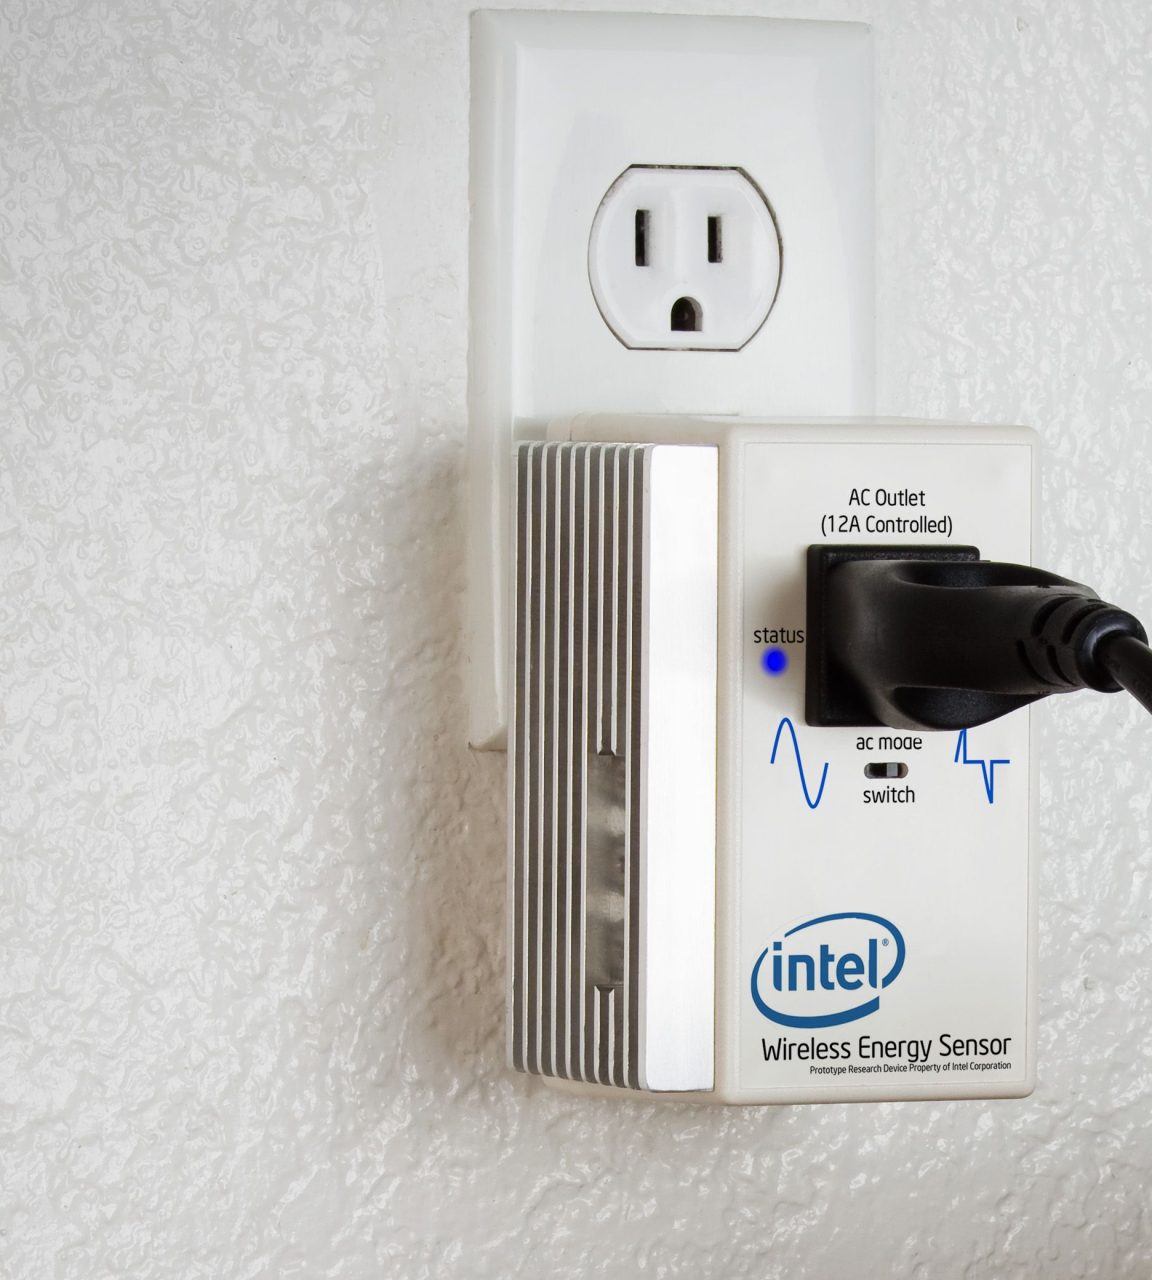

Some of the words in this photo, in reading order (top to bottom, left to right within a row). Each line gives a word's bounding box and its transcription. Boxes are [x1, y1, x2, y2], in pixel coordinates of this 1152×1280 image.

[848, 488, 871, 507] AC
[875, 488, 926, 507] Outlet
[821, 514, 861, 537] (12A
[865, 515, 953, 538] Controlled)
[753, 627, 805, 644] status
[856, 736, 874, 751] ac
[863, 785, 915, 804] switch
[772, 938, 878, 992] intel
[761, 1036, 851, 1062] Wireless
[858, 1035, 933, 1063] Energy
[939, 1033, 1012, 1057] Sensor
[809, 1065, 847, 1076] Prototype
[848, 1064, 882, 1074] Research
[883, 1063, 908, 1073] Device
[908, 1063, 942, 1074] Property
[942, 1062, 951, 1072] of
[952, 1062, 969, 1071] Intel
[969, 1060, 1012, 1072] Corporation
